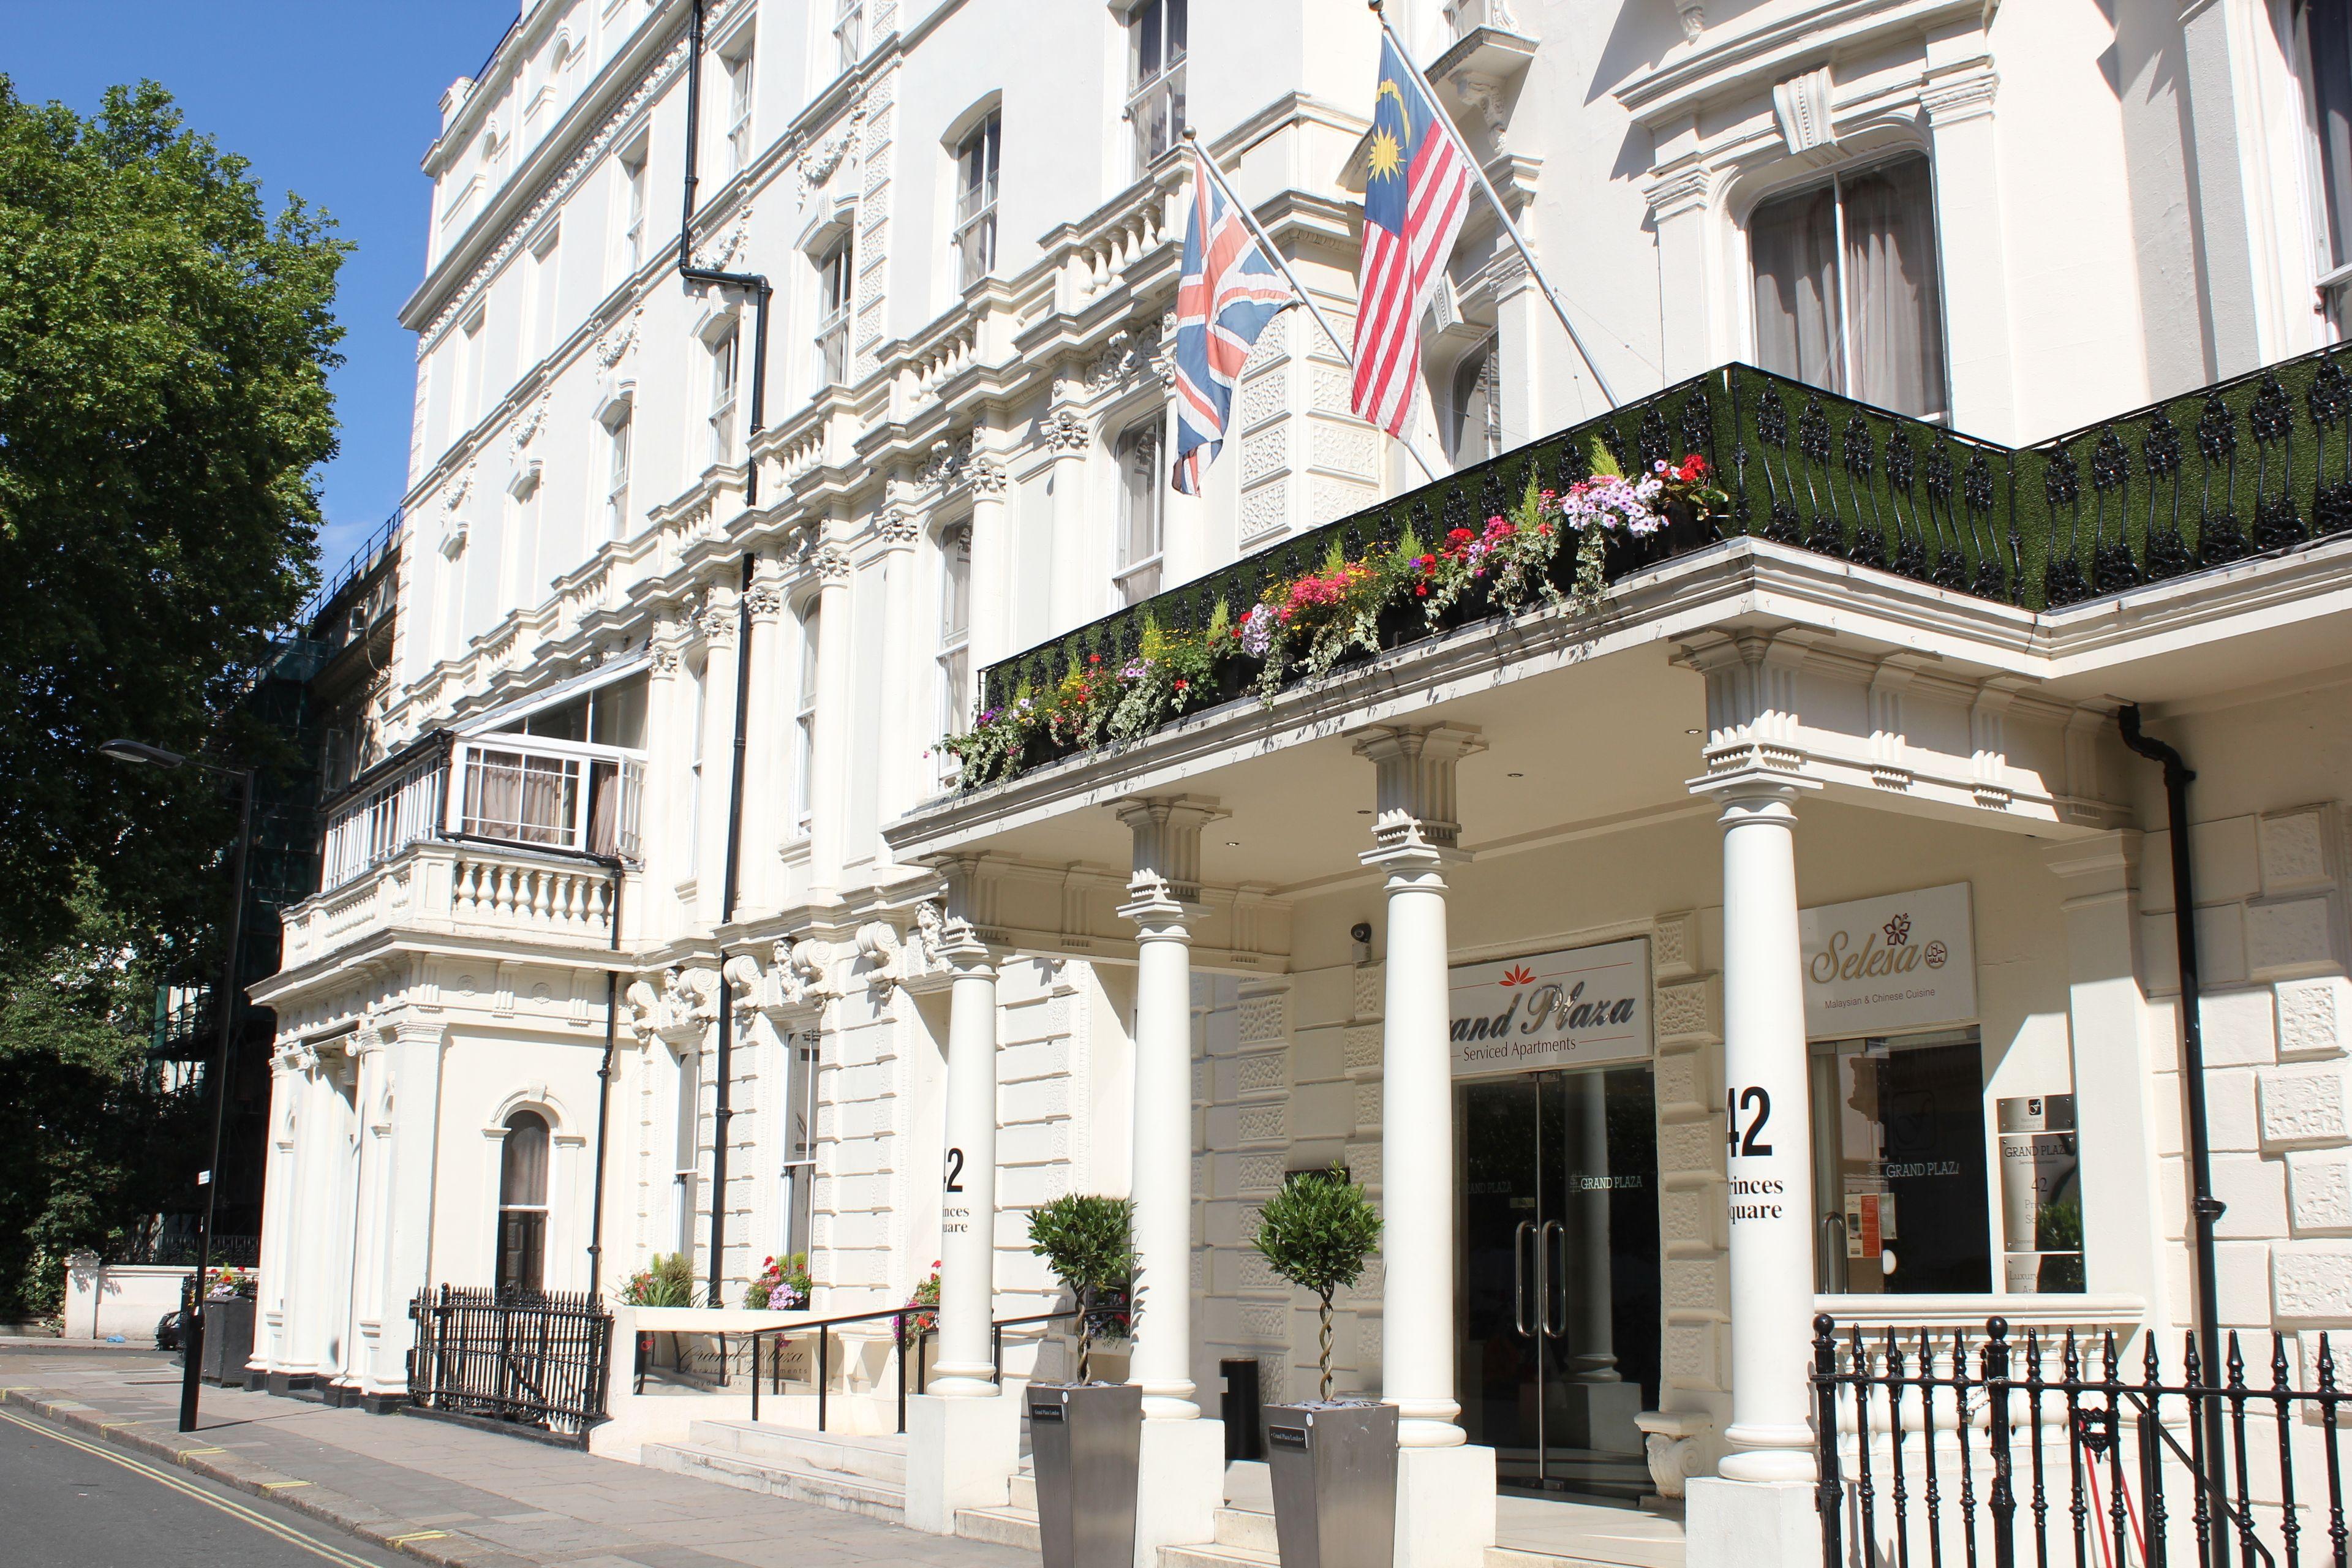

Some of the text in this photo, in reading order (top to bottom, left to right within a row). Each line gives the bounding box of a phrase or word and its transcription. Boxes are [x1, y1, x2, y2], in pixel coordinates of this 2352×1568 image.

[1810, 930, 1921, 984] Selesa
[1825, 989, 1936, 1009] Malaysian & Chinese Cuisine
[1450, 981, 1635, 1042] and Plaza
[1464, 1037, 1576, 1061] Serviced Apartments
[1726, 1087, 1773, 1157] 42
[2005, 1144, 2067, 1157] GRAND PLAZ
[943, 1148, 963, 1192] 2
[1887, 1164, 1925, 1177] GRAND
[1581, 1175, 1643, 1189] GRAND PLAZA
[1728, 1175, 1783, 1195] rinces
[2031, 1177, 2048, 1192] 42
[1729, 1205, 1782, 1224] quare
[943, 1223, 968, 1233] uare
